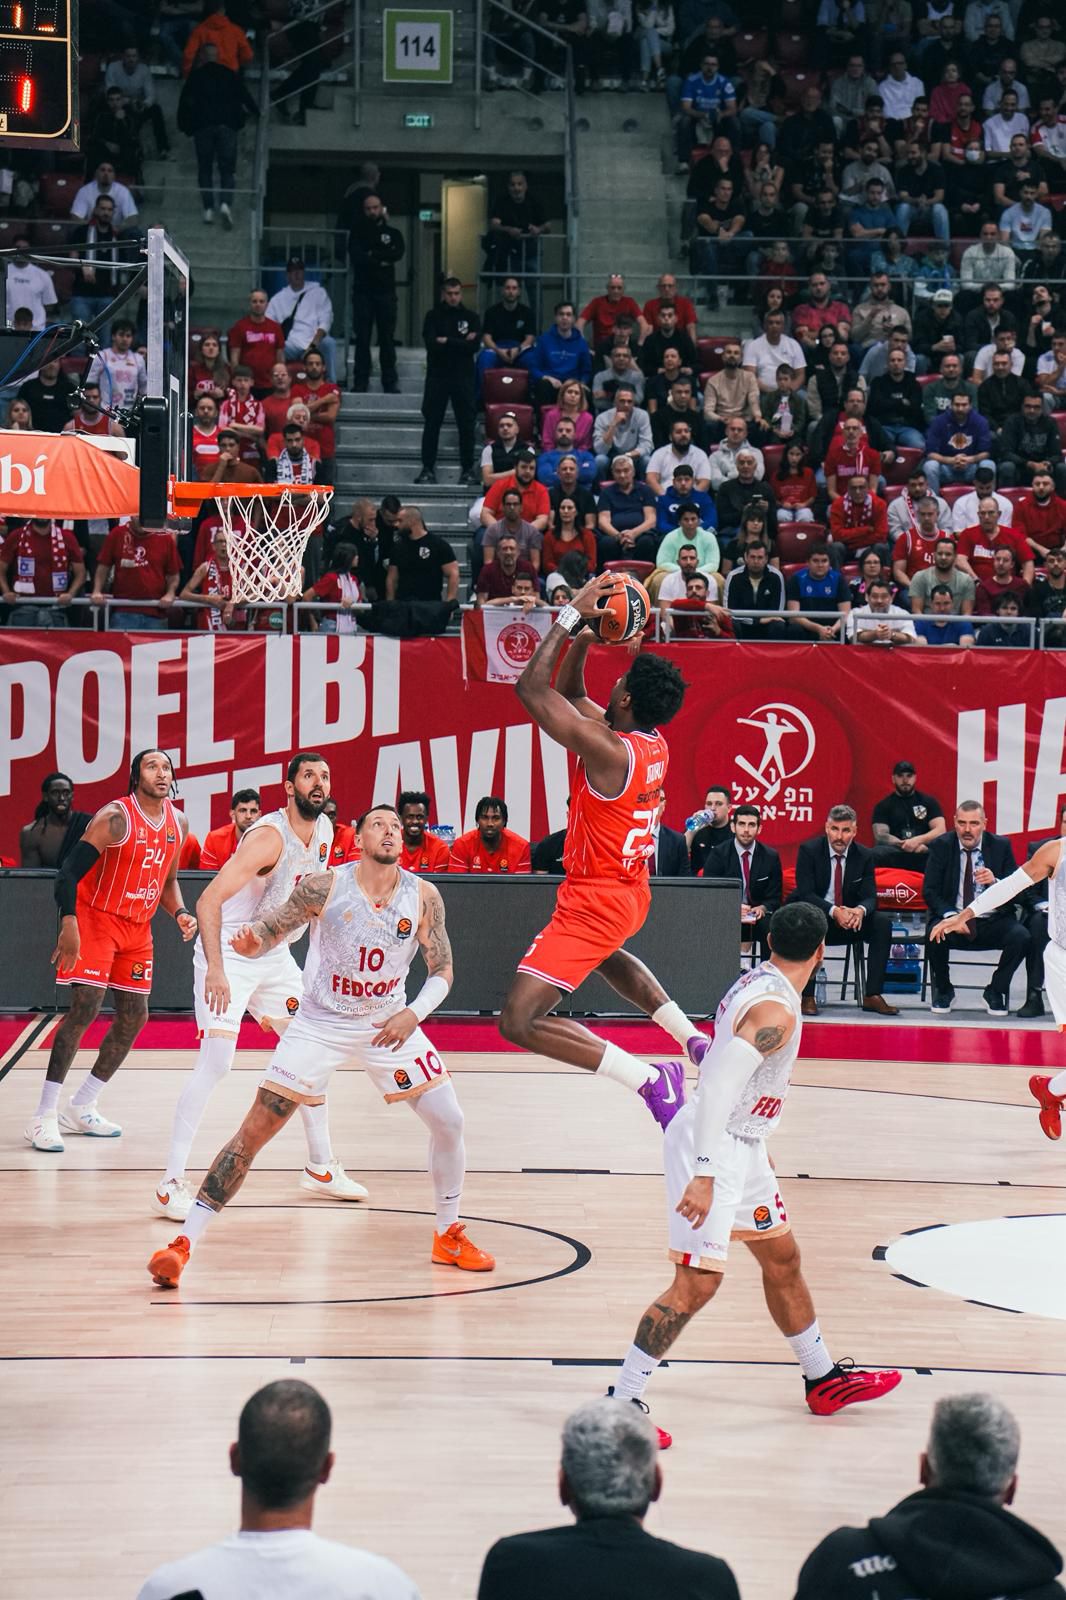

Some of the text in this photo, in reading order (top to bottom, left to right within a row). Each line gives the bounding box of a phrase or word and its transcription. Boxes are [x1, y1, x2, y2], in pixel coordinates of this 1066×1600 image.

[400, 35, 436, 57] 114
[264, 635, 400, 755] IBI
[142, 849, 166, 868] 24
[359, 946, 384, 972] 10
[414, 1050, 443, 1082] 10
